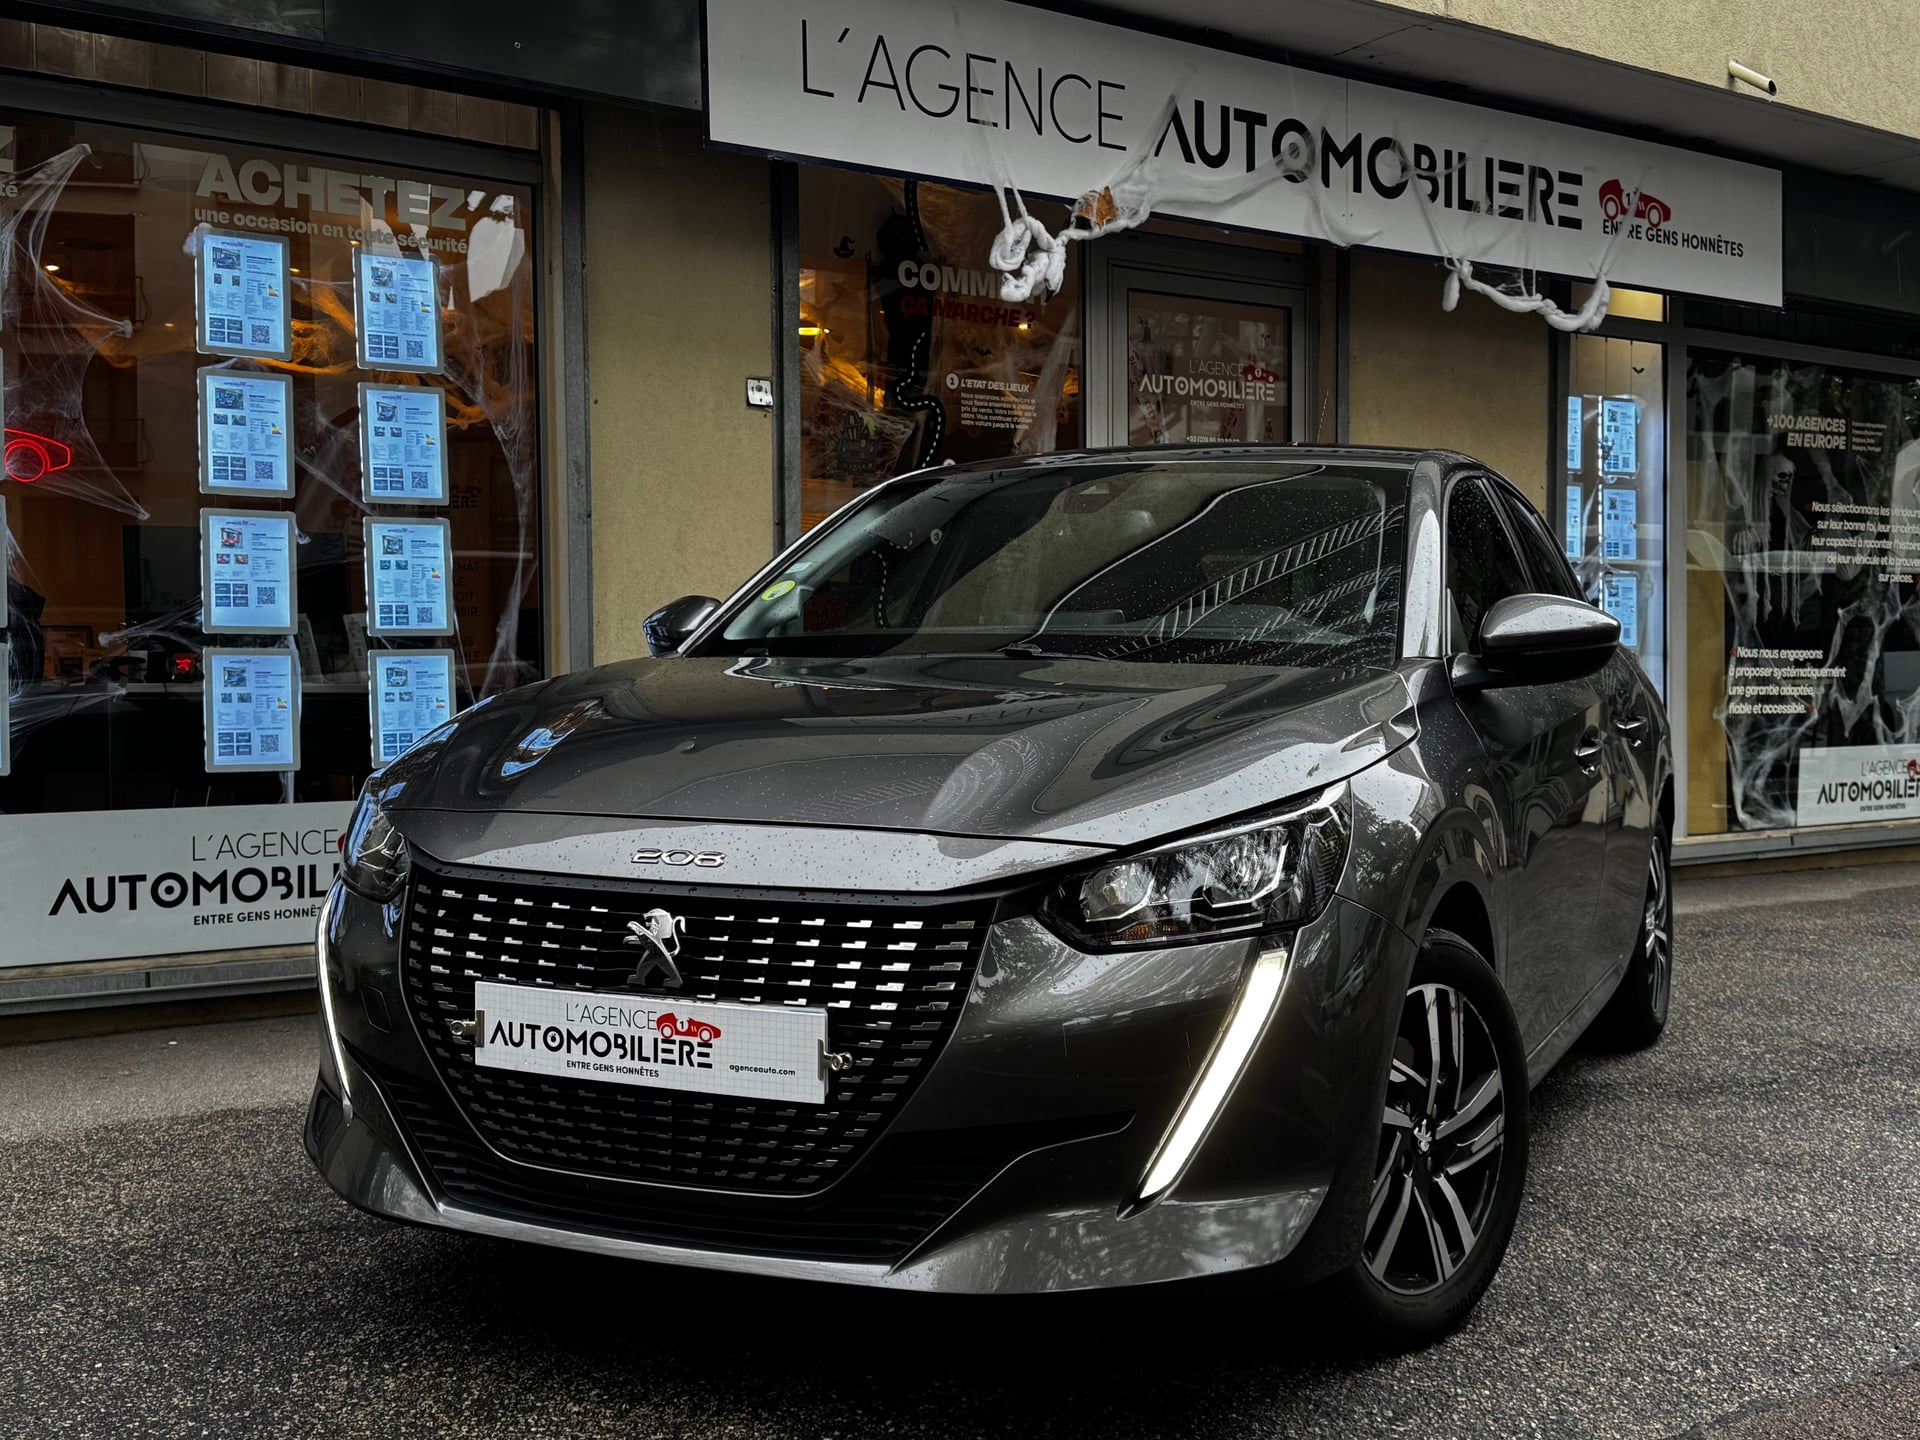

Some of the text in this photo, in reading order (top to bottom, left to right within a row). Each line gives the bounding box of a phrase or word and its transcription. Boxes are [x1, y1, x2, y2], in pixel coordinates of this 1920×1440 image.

[802, 19, 1127, 151] L'AGENCE
[195, 152, 466, 231] ACHETEZ
[194, 207, 468, 254] une occasion en toute sécurité
[1602, 218, 1744, 258] ENRE GENS HONNÊTES
[933, 298, 1022, 328] MARCHE
[1189, 359, 1245, 377] L'AGENCE
[961, 378, 1030, 393] L'ETAT DES LIEUX
[1766, 413, 1795, 430] +100
[1795, 414, 1847, 433] AGENCES
[1786, 432, 1802, 448] EN
[1803, 433, 1847, 450] EUROPE
[1811, 501, 1831, 513] Nous
[1880, 505, 1890, 516] les
[1817, 520, 1829, 529] sur
[1829, 519, 1843, 530] leur
[1843, 519, 1865, 531] bonne
[1877, 523, 1891, 533] leur
[1811, 535, 1826, 546] leur
[1826, 536, 1857, 548] capacité
[1863, 539, 1893, 549] raconter
[1827, 554, 1837, 564] de
[1837, 554, 1851, 564] leur
[1851, 554, 1880, 565] véhicule
[1881, 556, 1888, 566] et
[1878, 573, 1889, 583] sur
[1737, 646, 1824, 661] Nous nous engageons
[1735, 667, 1772, 679] proposer
[1773, 665, 1847, 679] systématiquement
[1728, 684, 1744, 696] une
[1745, 683, 1779, 697] garantie
[1728, 702, 1752, 714] fiable
[1753, 703, 1762, 714] et
[1861, 759, 1908, 777] L'AGENCE
[192, 829, 338, 862] L'AGENCE
[630, 847, 729, 868] 208
[193, 913, 234, 926] ENTRE
[237, 910, 271, 922] GENS
[566, 1002, 657, 1031] L'AGENCE
[566, 1060, 796, 1078] ENTRE GENS HONNÊTES agenceauto.com
